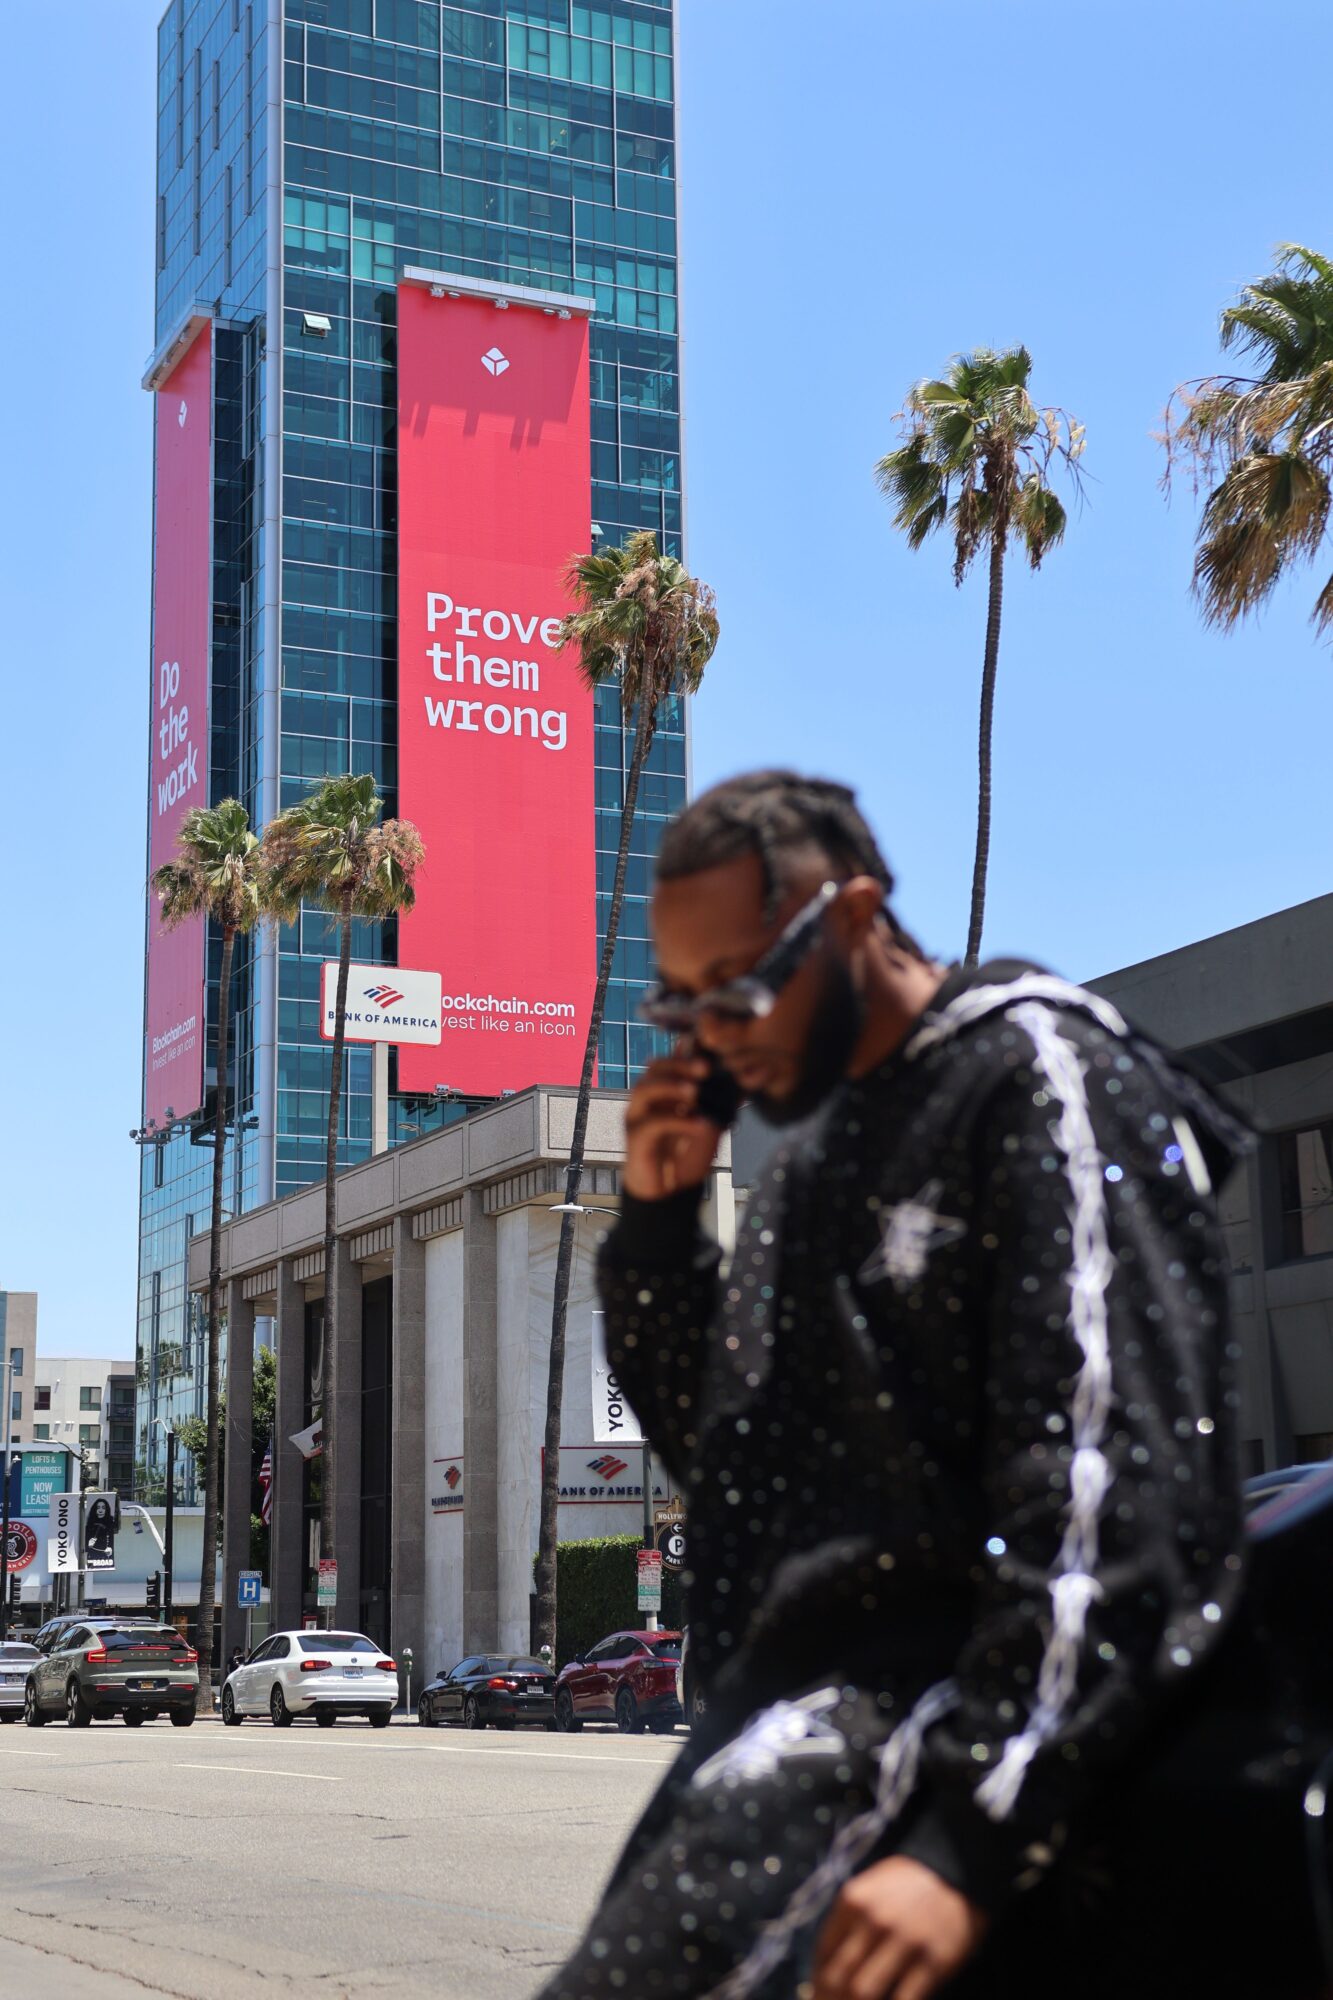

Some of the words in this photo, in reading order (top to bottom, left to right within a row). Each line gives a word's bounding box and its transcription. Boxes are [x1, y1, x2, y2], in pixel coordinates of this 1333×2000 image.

[426, 592, 563, 648] Prove
[426, 641, 539, 692] them
[159, 705, 189, 760] the
[424, 696, 568, 751] wrong
[158, 740, 199, 816] work
[442, 993, 575, 1017] ockchain.com
[328, 1011, 361, 1022] BNK
[365, 1014, 380, 1023] OF
[383, 1016, 437, 1029] AMERICA
[481, 1016, 509, 1032] like
[515, 1021, 534, 1033] an
[540, 1021, 575, 1037] icon
[152, 1016, 196, 1054] Blockchain.com
[25, 1466, 62, 1474] PENTHOUSES
[32, 1455, 50, 1463] LOFTS
[51, 1455, 56, 1463] &
[33, 1482, 53, 1492] NOW
[589, 1487, 605, 1496] OF
[608, 1486, 662, 1496] AMERA
[26, 1494, 50, 1505] LEASI
[58, 1499, 69, 1527] ONO
[57, 1531, 69, 1567] YOKO
[243, 1581, 257, 1598] H
